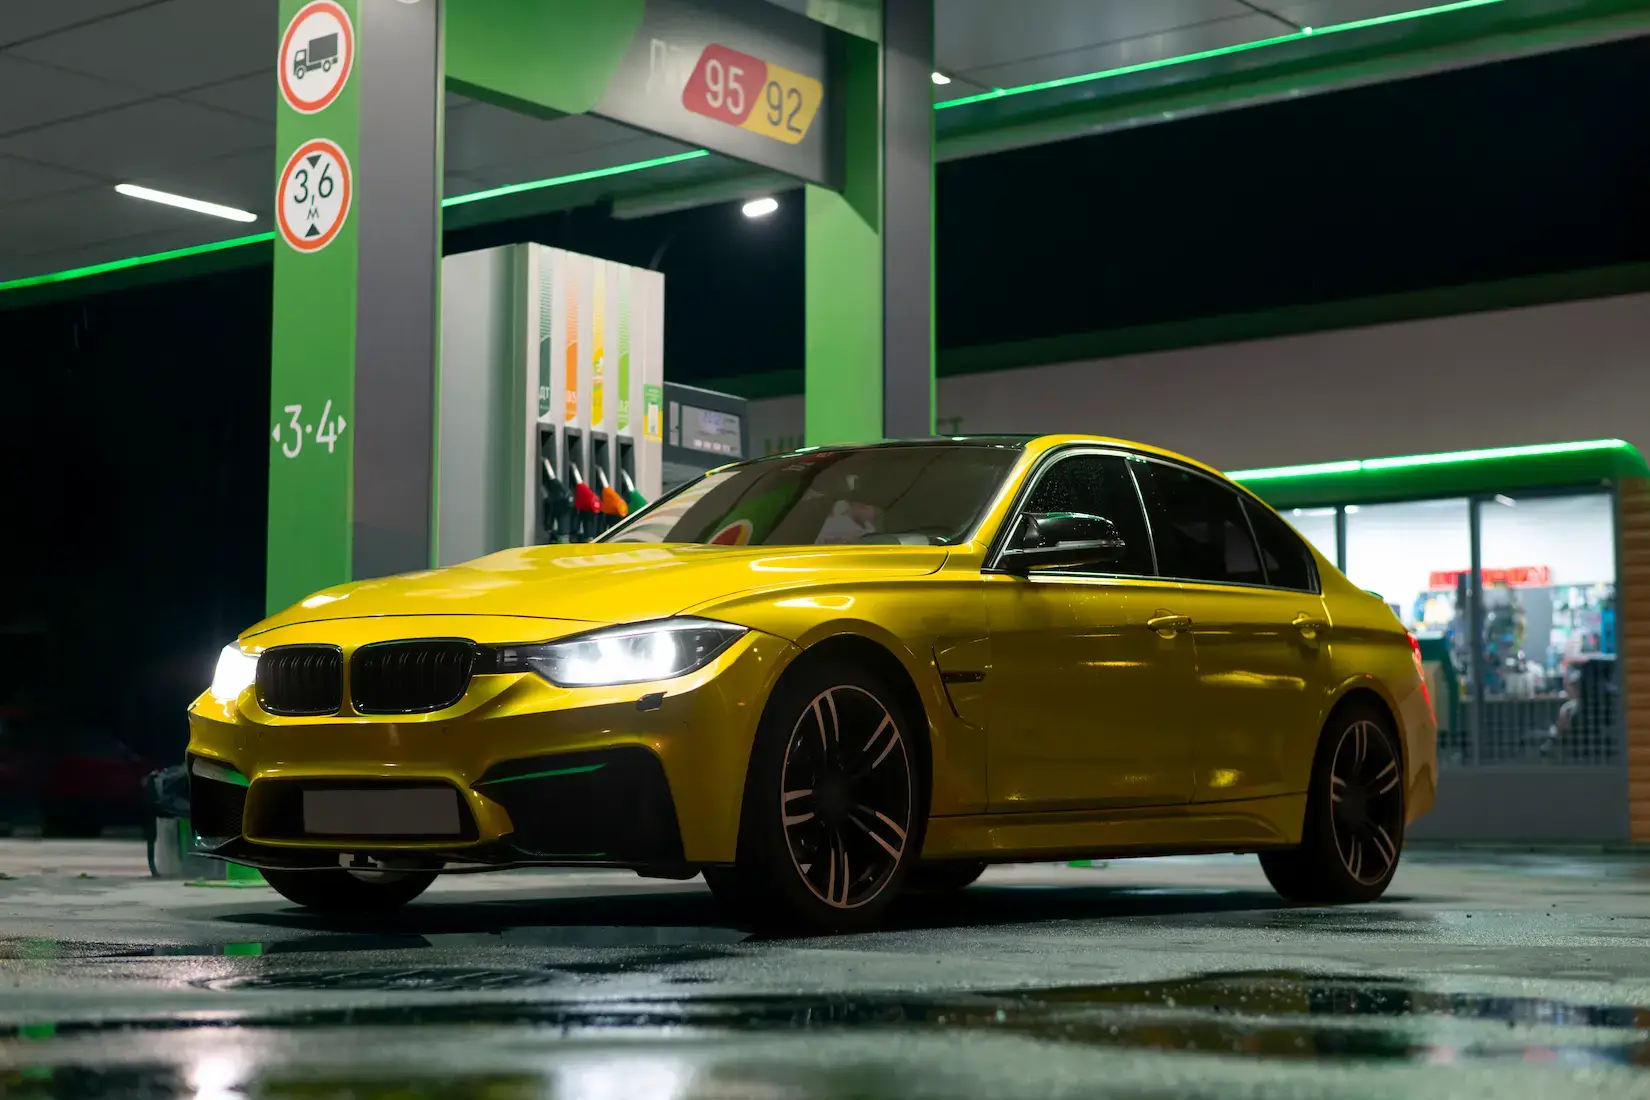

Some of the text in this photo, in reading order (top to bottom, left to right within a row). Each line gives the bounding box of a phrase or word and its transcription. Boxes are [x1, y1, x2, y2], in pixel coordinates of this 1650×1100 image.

[705, 58, 745, 116] 95
[766, 80, 804, 135] 92
[293, 162, 334, 206] 3,6
